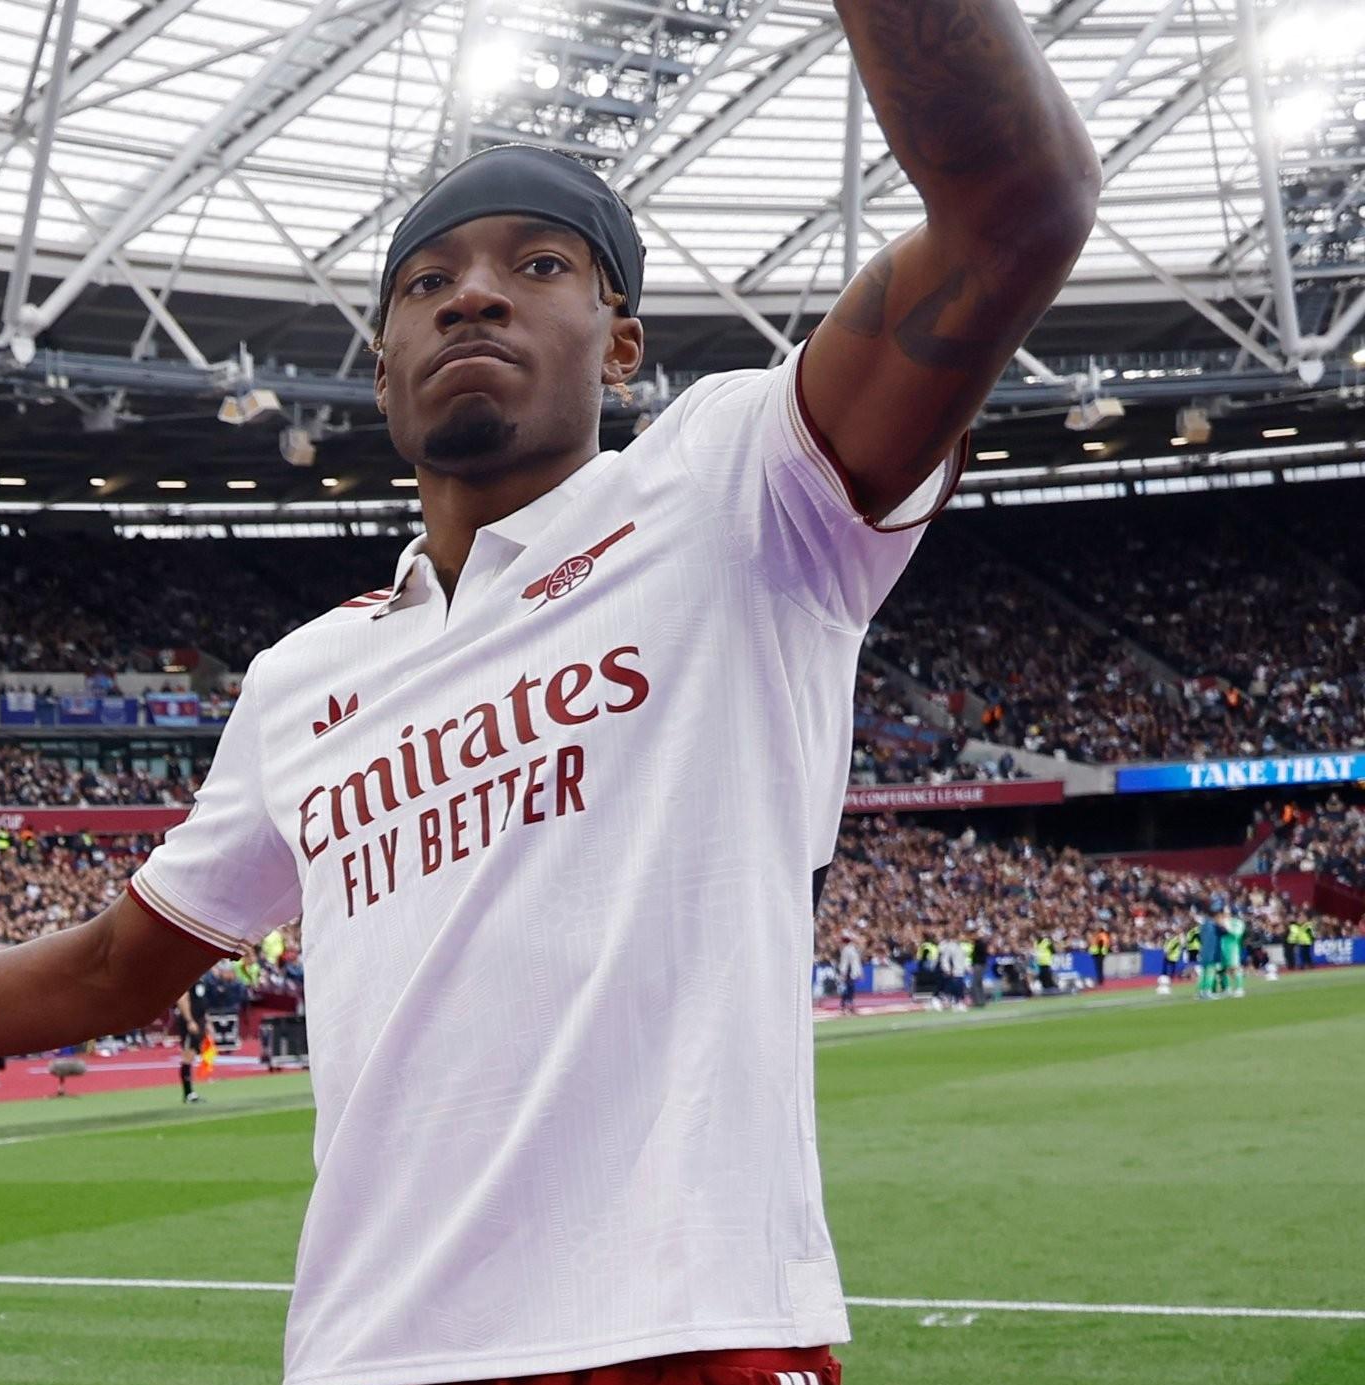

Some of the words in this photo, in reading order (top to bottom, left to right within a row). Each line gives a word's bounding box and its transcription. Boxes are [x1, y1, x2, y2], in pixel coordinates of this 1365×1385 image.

[298, 645, 650, 865] Emirates
[342, 827, 399, 919] FLY
[419, 745, 586, 877] BETTER
[1186, 760, 1268, 788] TAKE
[1273, 755, 1356, 783] THAT
